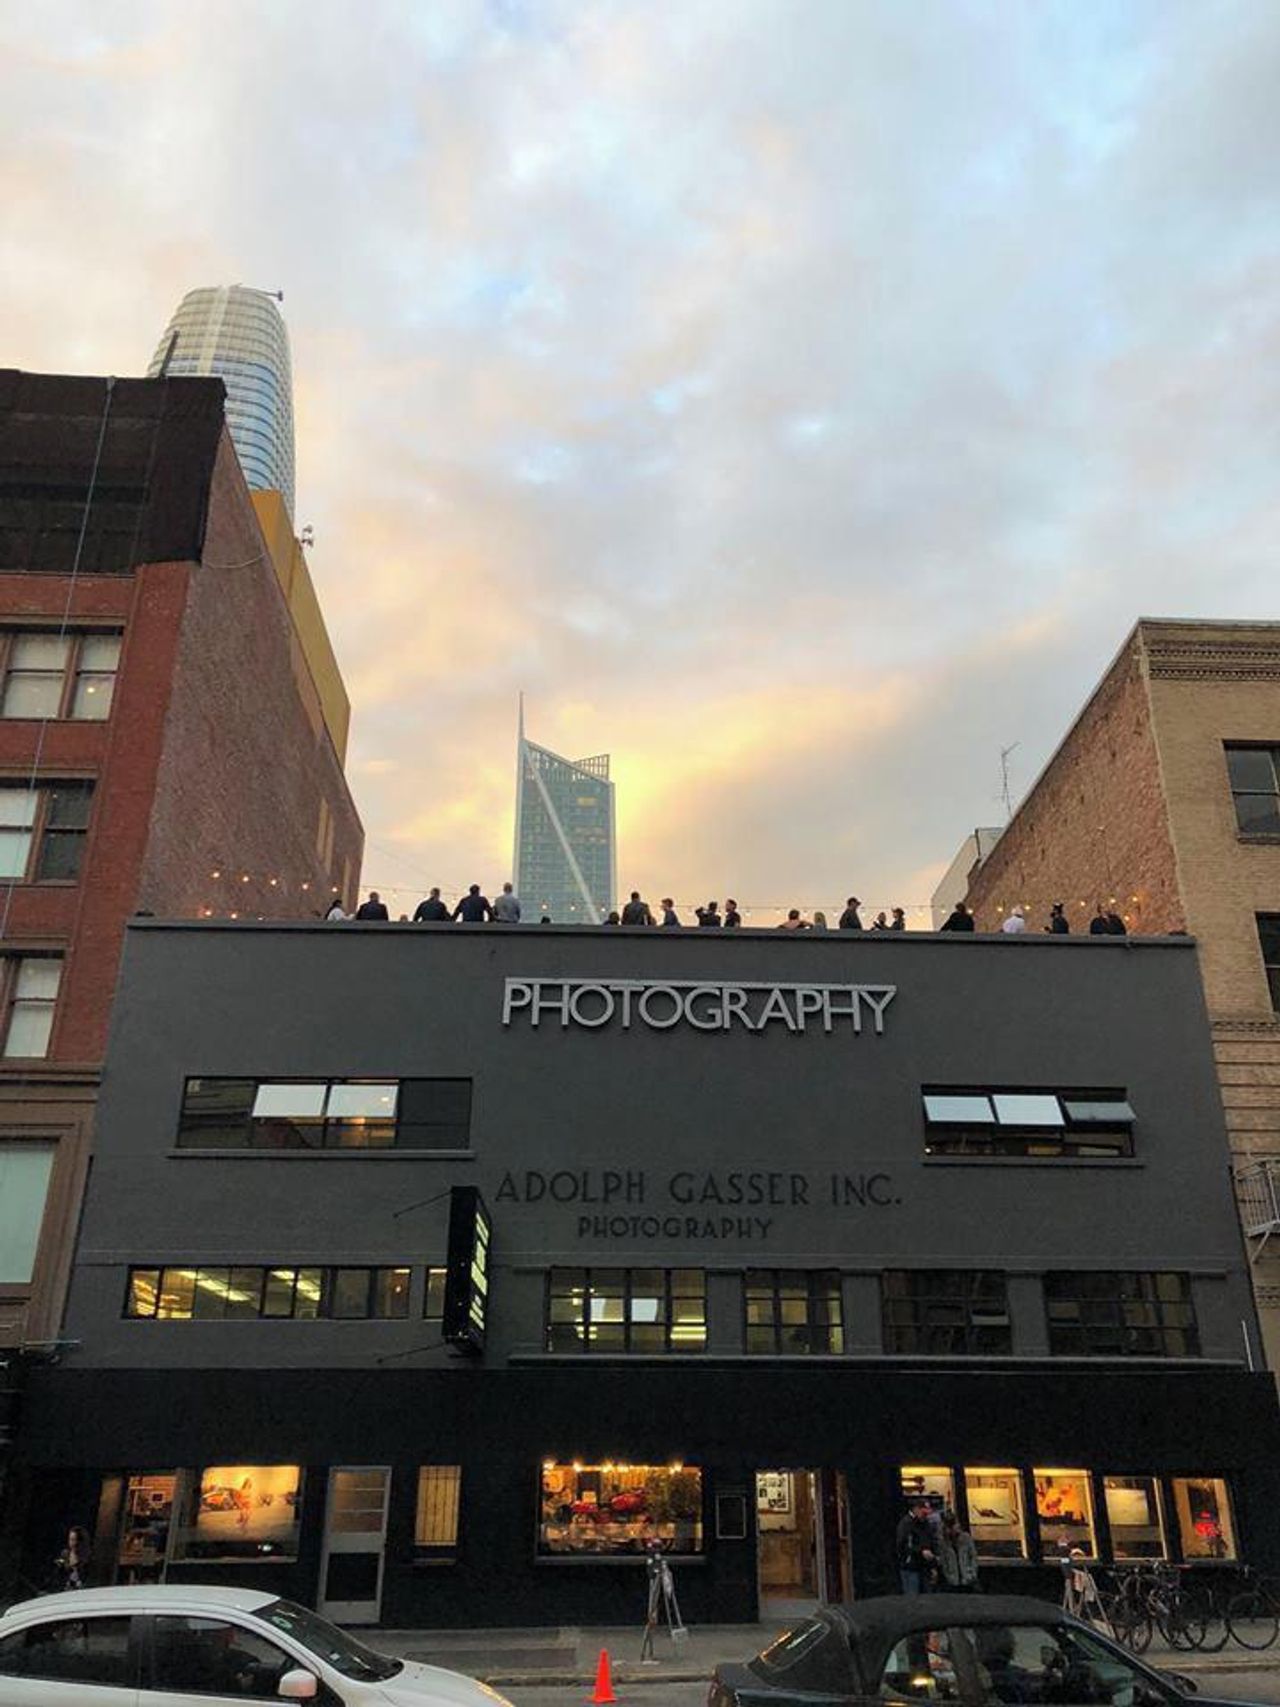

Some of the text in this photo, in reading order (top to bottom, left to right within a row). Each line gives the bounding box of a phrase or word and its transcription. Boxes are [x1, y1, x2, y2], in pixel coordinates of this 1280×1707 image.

[502, 978, 897, 1034] PHOTOGRAPHY
[496, 1171, 902, 1207] ADOLPH GASSER INC.
[578, 1216, 772, 1240] PHOTOGRAPHY
